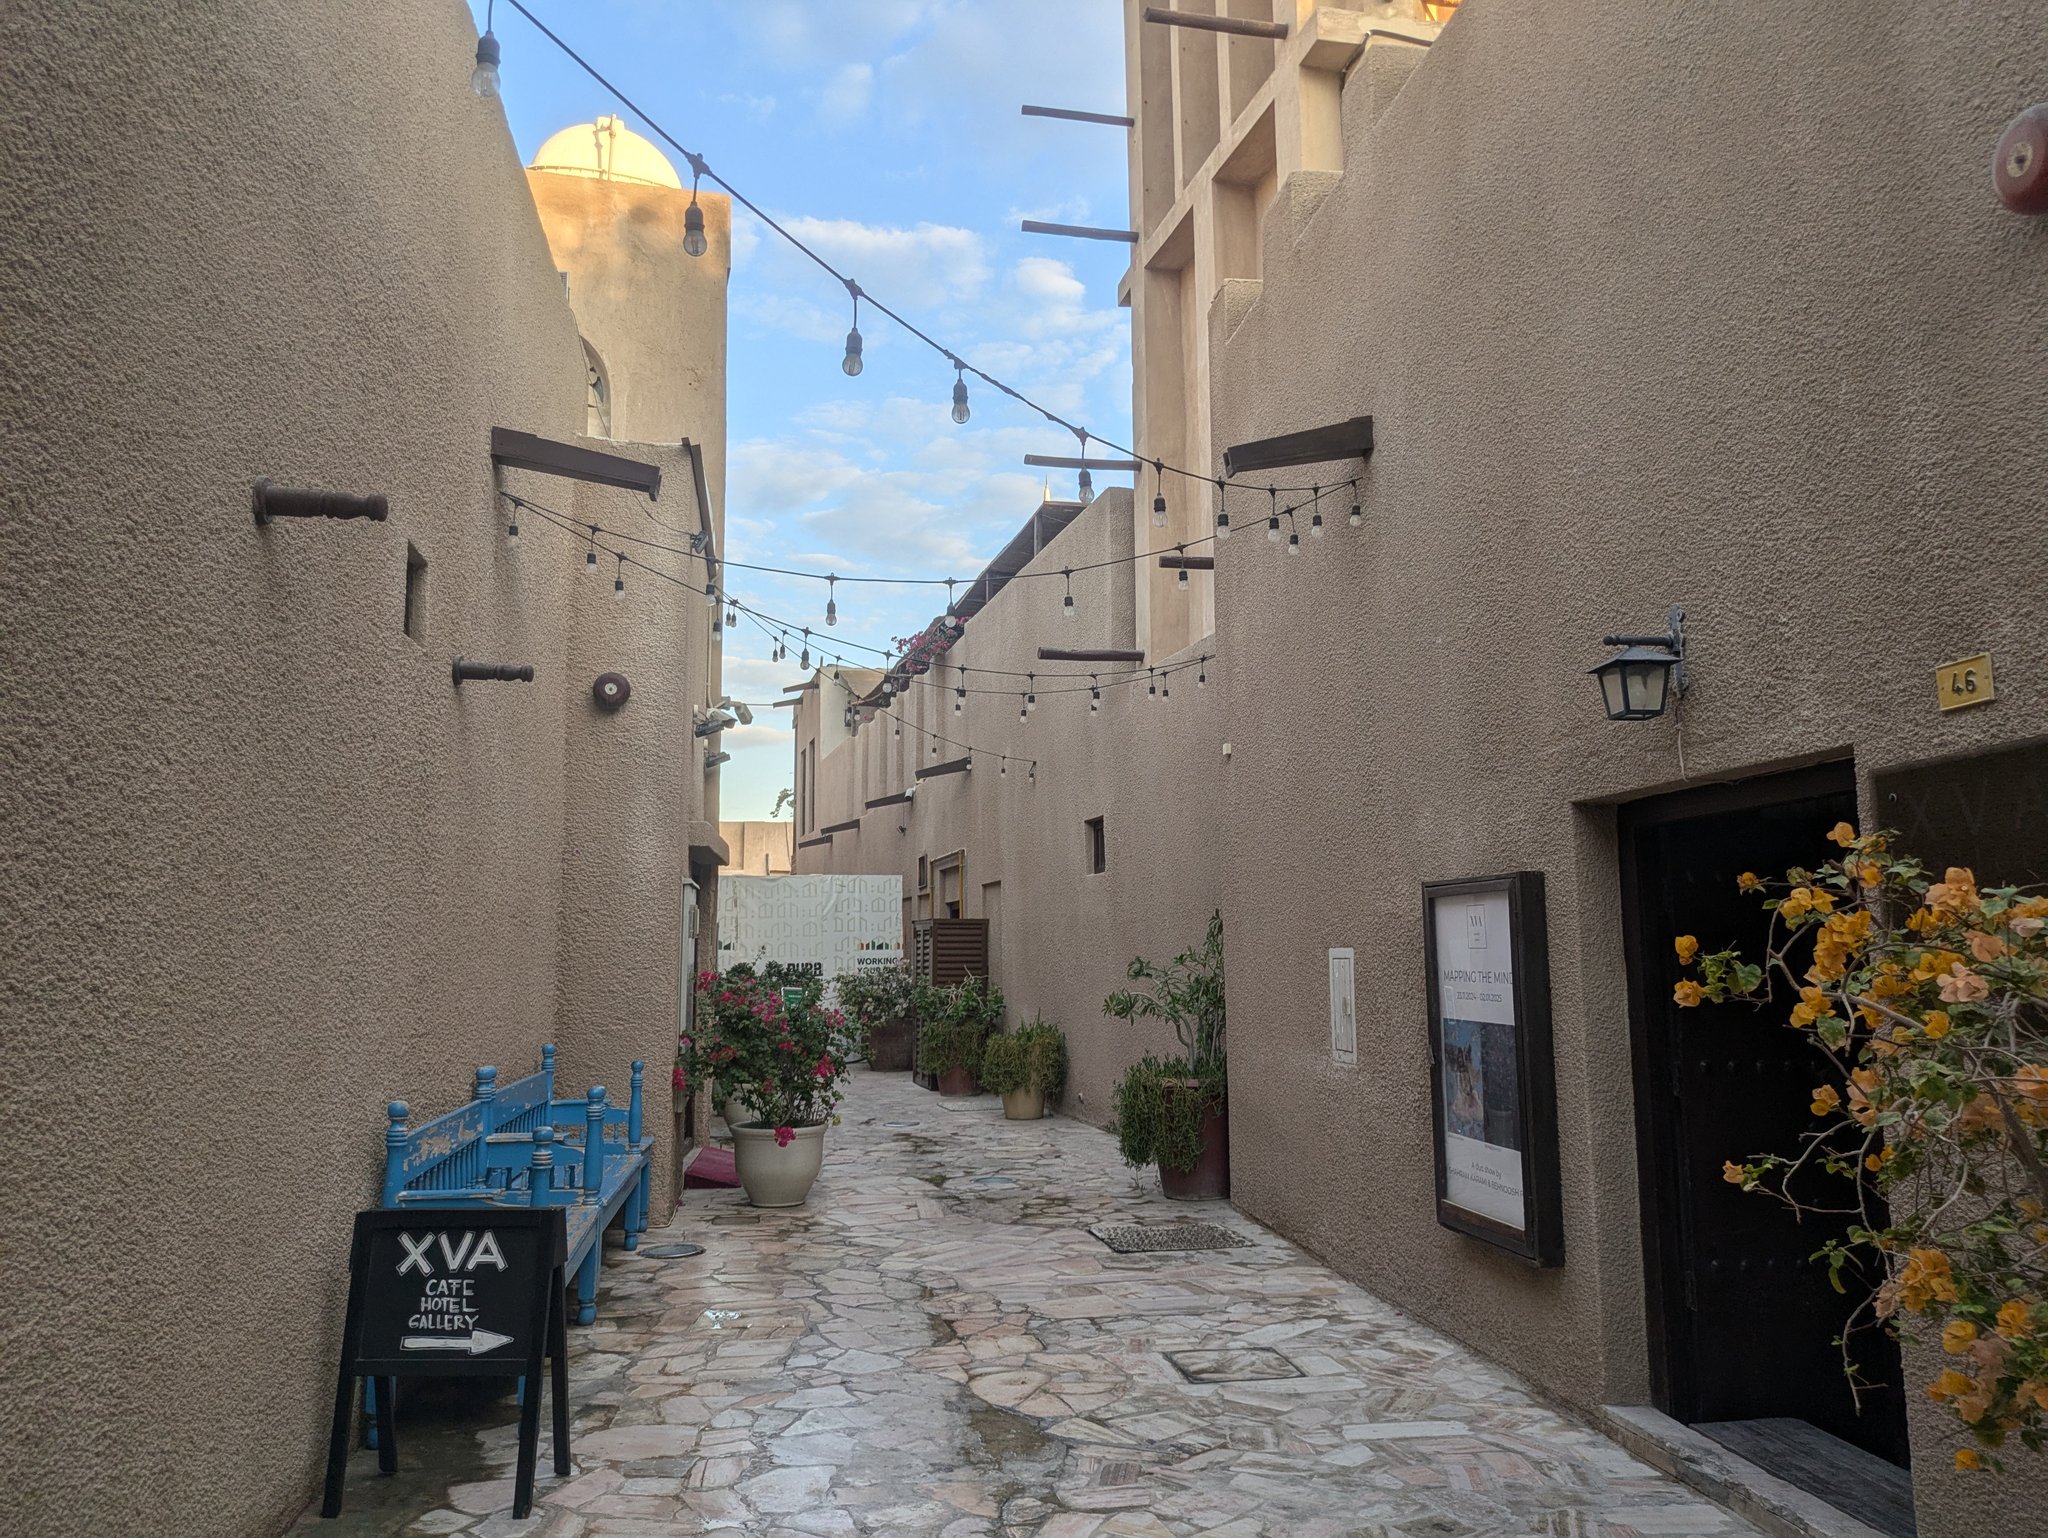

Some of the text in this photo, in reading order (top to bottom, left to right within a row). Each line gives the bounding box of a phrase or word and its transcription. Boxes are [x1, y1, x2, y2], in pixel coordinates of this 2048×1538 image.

[1950, 669, 1977, 696] 46
[1443, 970, 1477, 983] MAPPING
[1477, 971, 1492, 984] THE
[396, 1229, 509, 1277] XVA
[425, 1279, 475, 1296] CAFE
[420, 1297, 480, 1313] HOTEL
[408, 1314, 480, 1331] GALLERY
